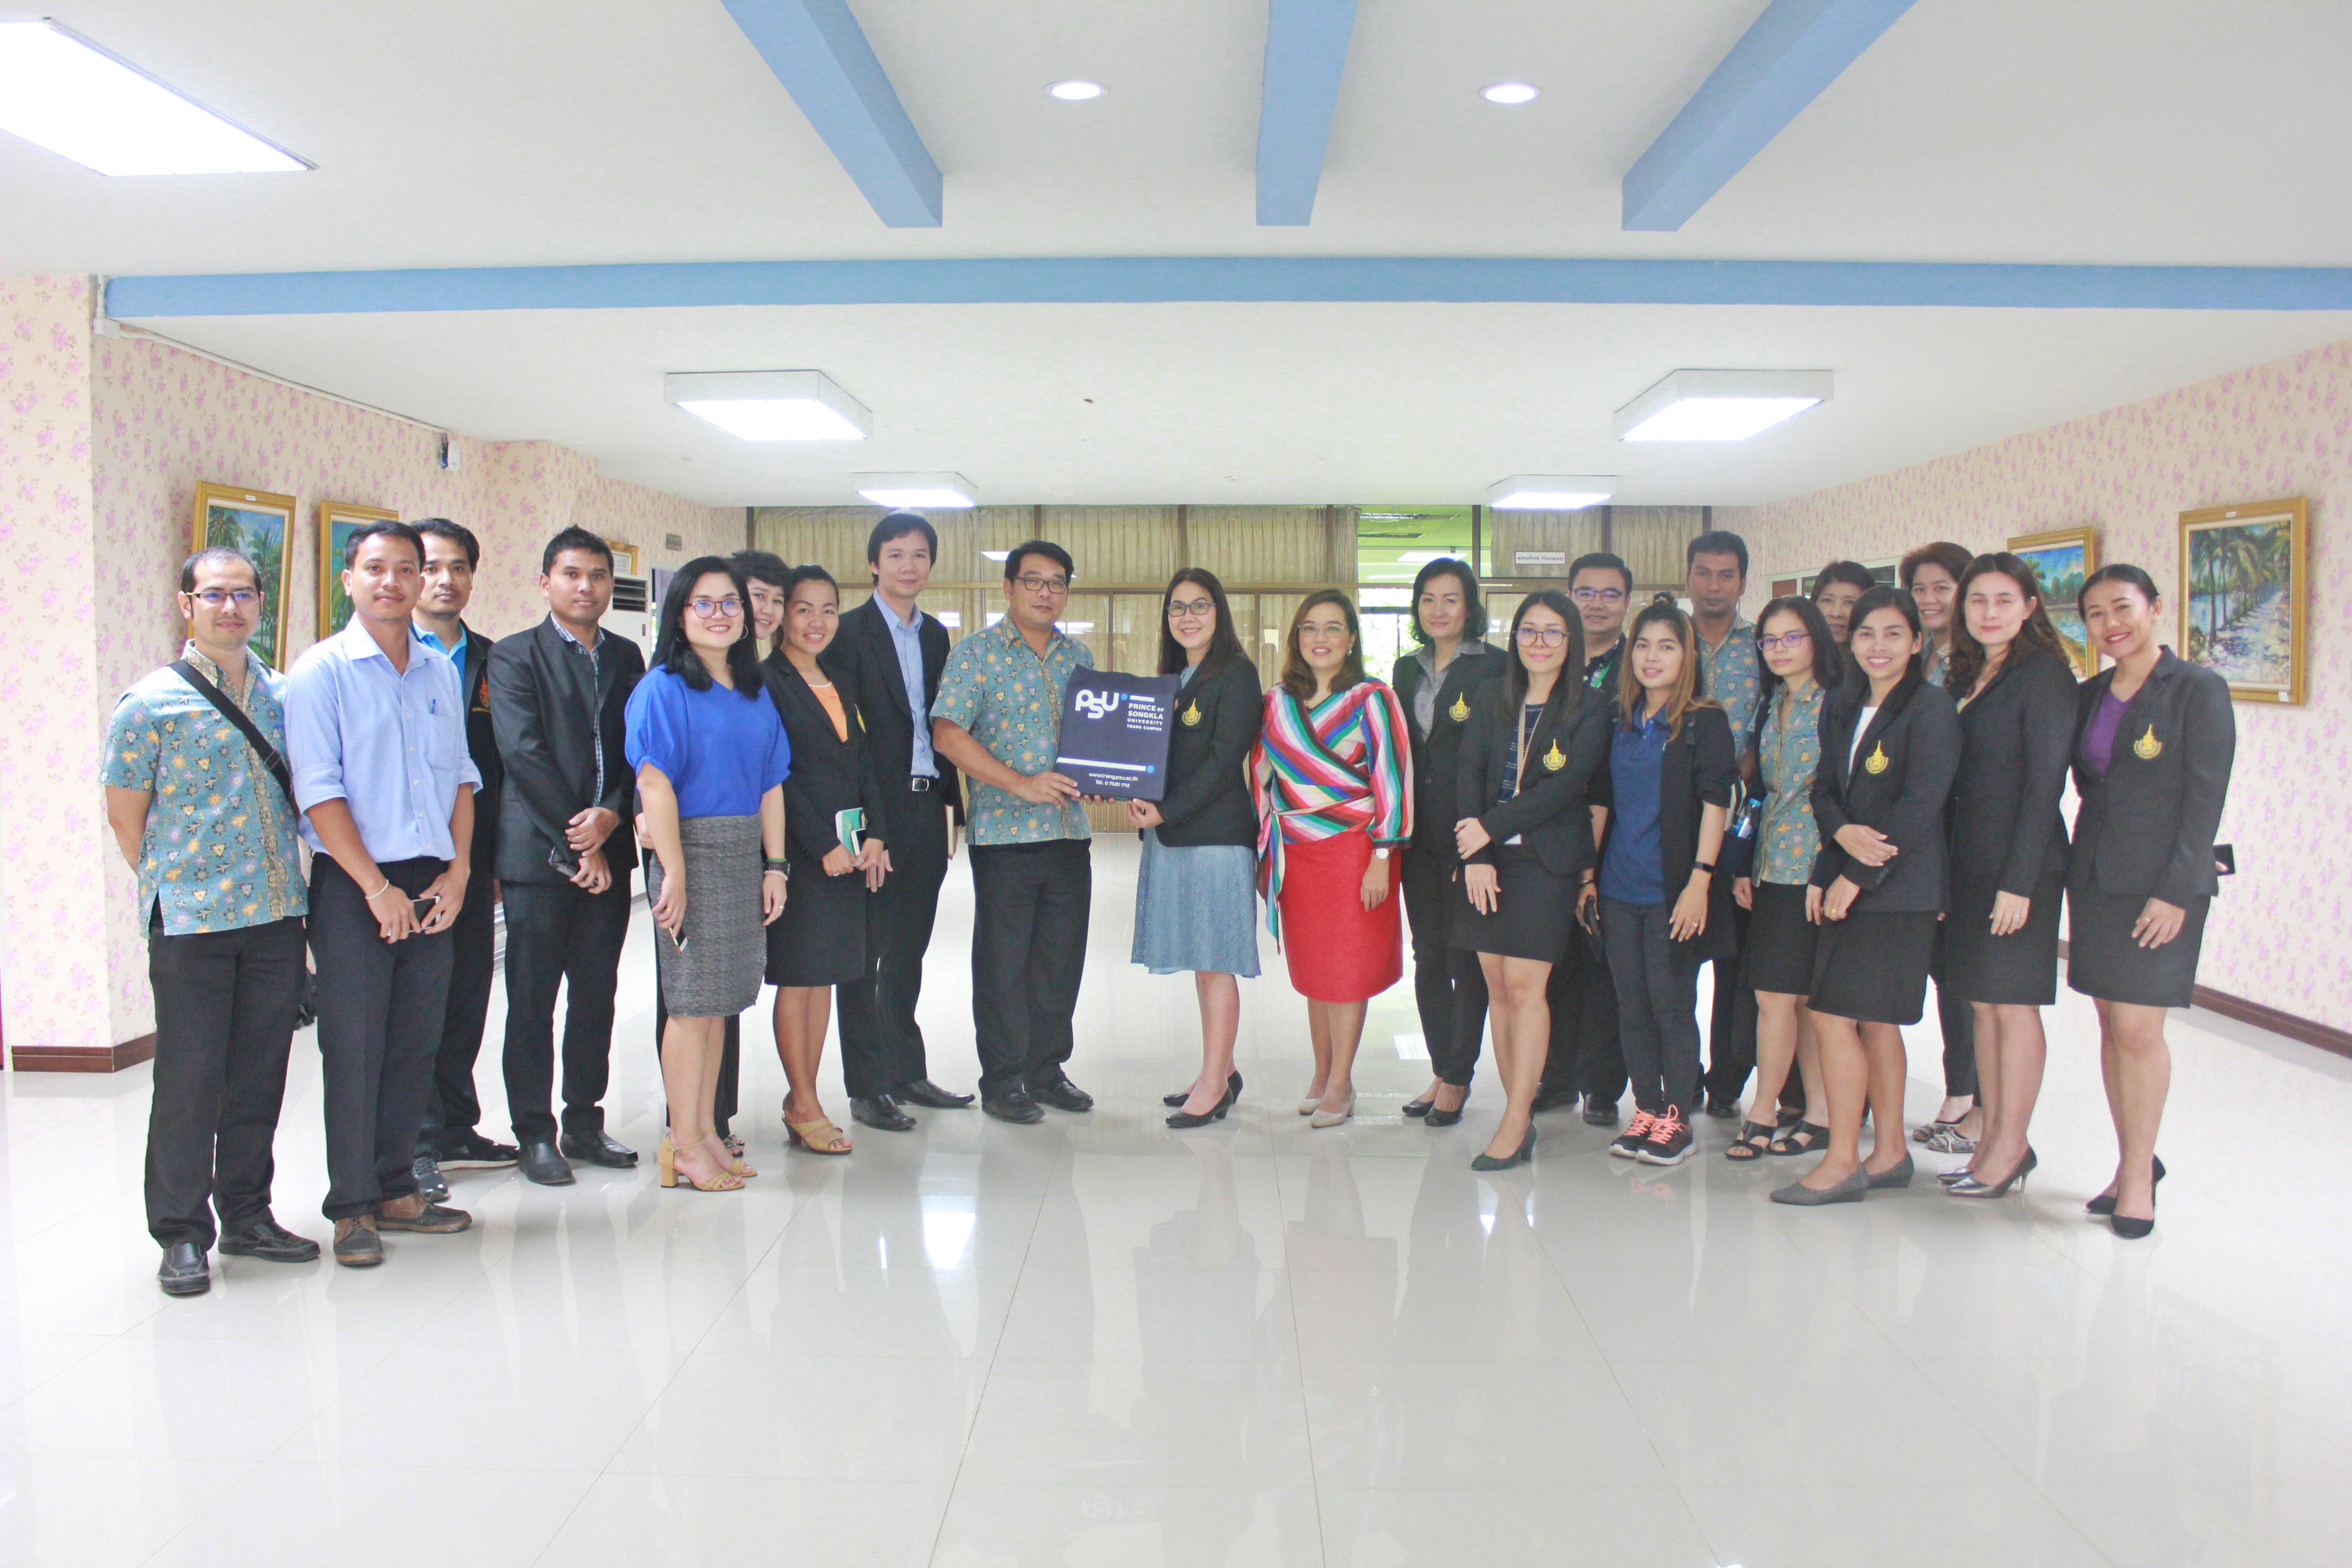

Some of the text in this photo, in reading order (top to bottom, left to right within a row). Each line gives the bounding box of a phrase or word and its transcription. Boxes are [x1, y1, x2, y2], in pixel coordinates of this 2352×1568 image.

[1075, 689, 1119, 719] PSU
[1128, 703, 1156, 711] PRINCE
[1128, 710, 1163, 720] SONGKLA
[1088, 773, 1138, 781] www.trang.psu.ac.th
